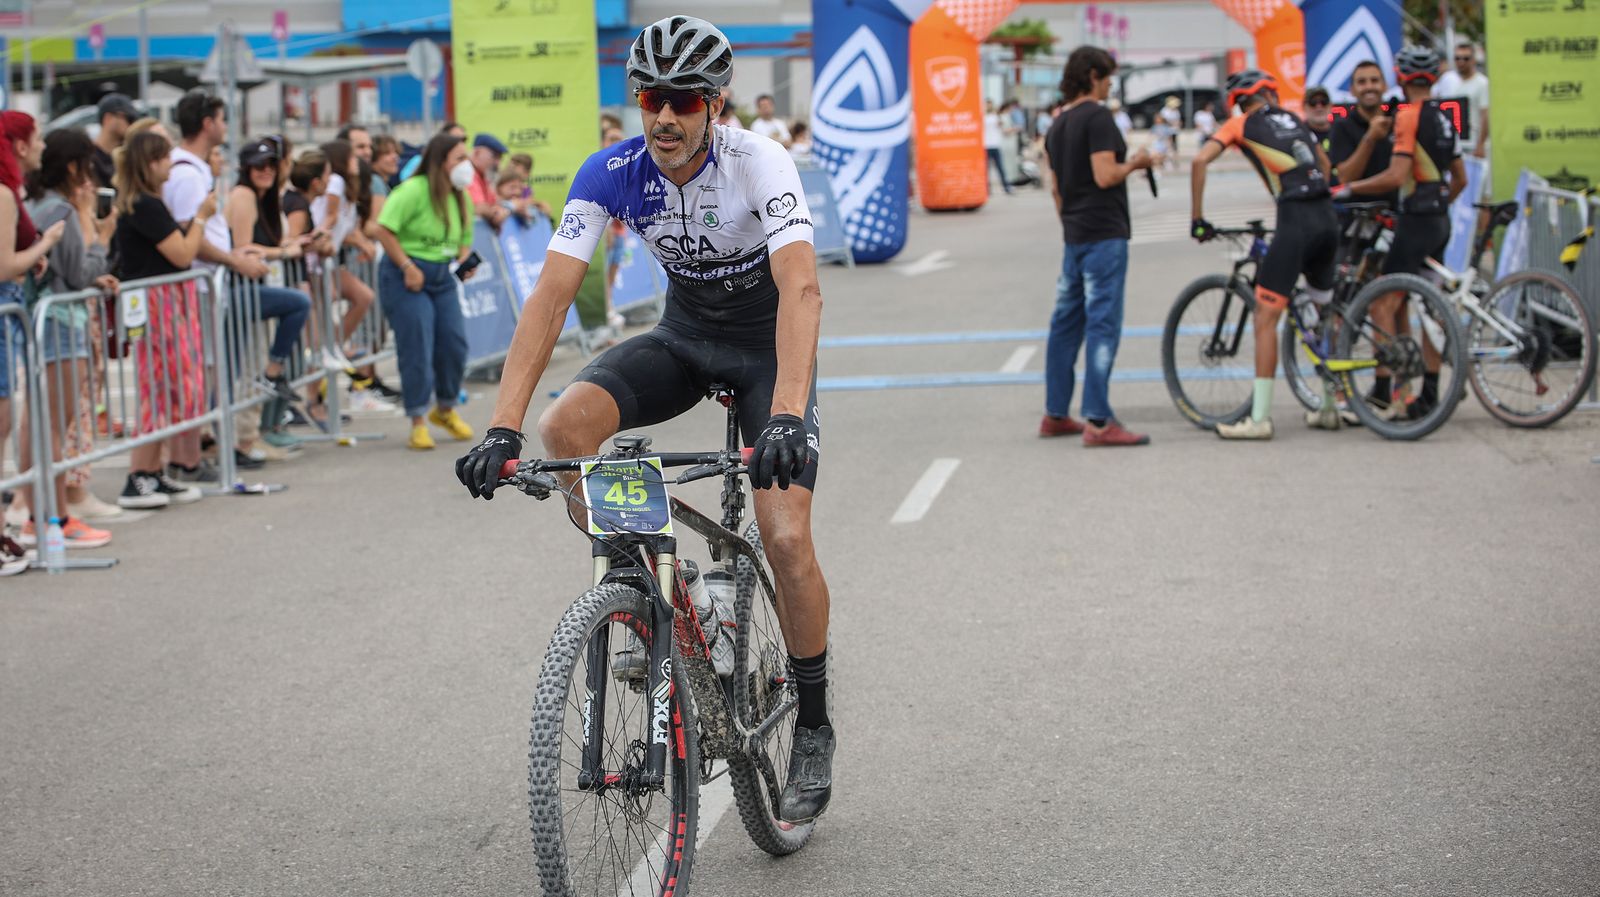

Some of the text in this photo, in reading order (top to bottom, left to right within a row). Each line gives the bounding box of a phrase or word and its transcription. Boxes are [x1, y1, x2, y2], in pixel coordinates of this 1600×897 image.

[655, 234, 719, 261] SCA
[604, 480, 648, 505] 45
[653, 698, 669, 744] FOX
